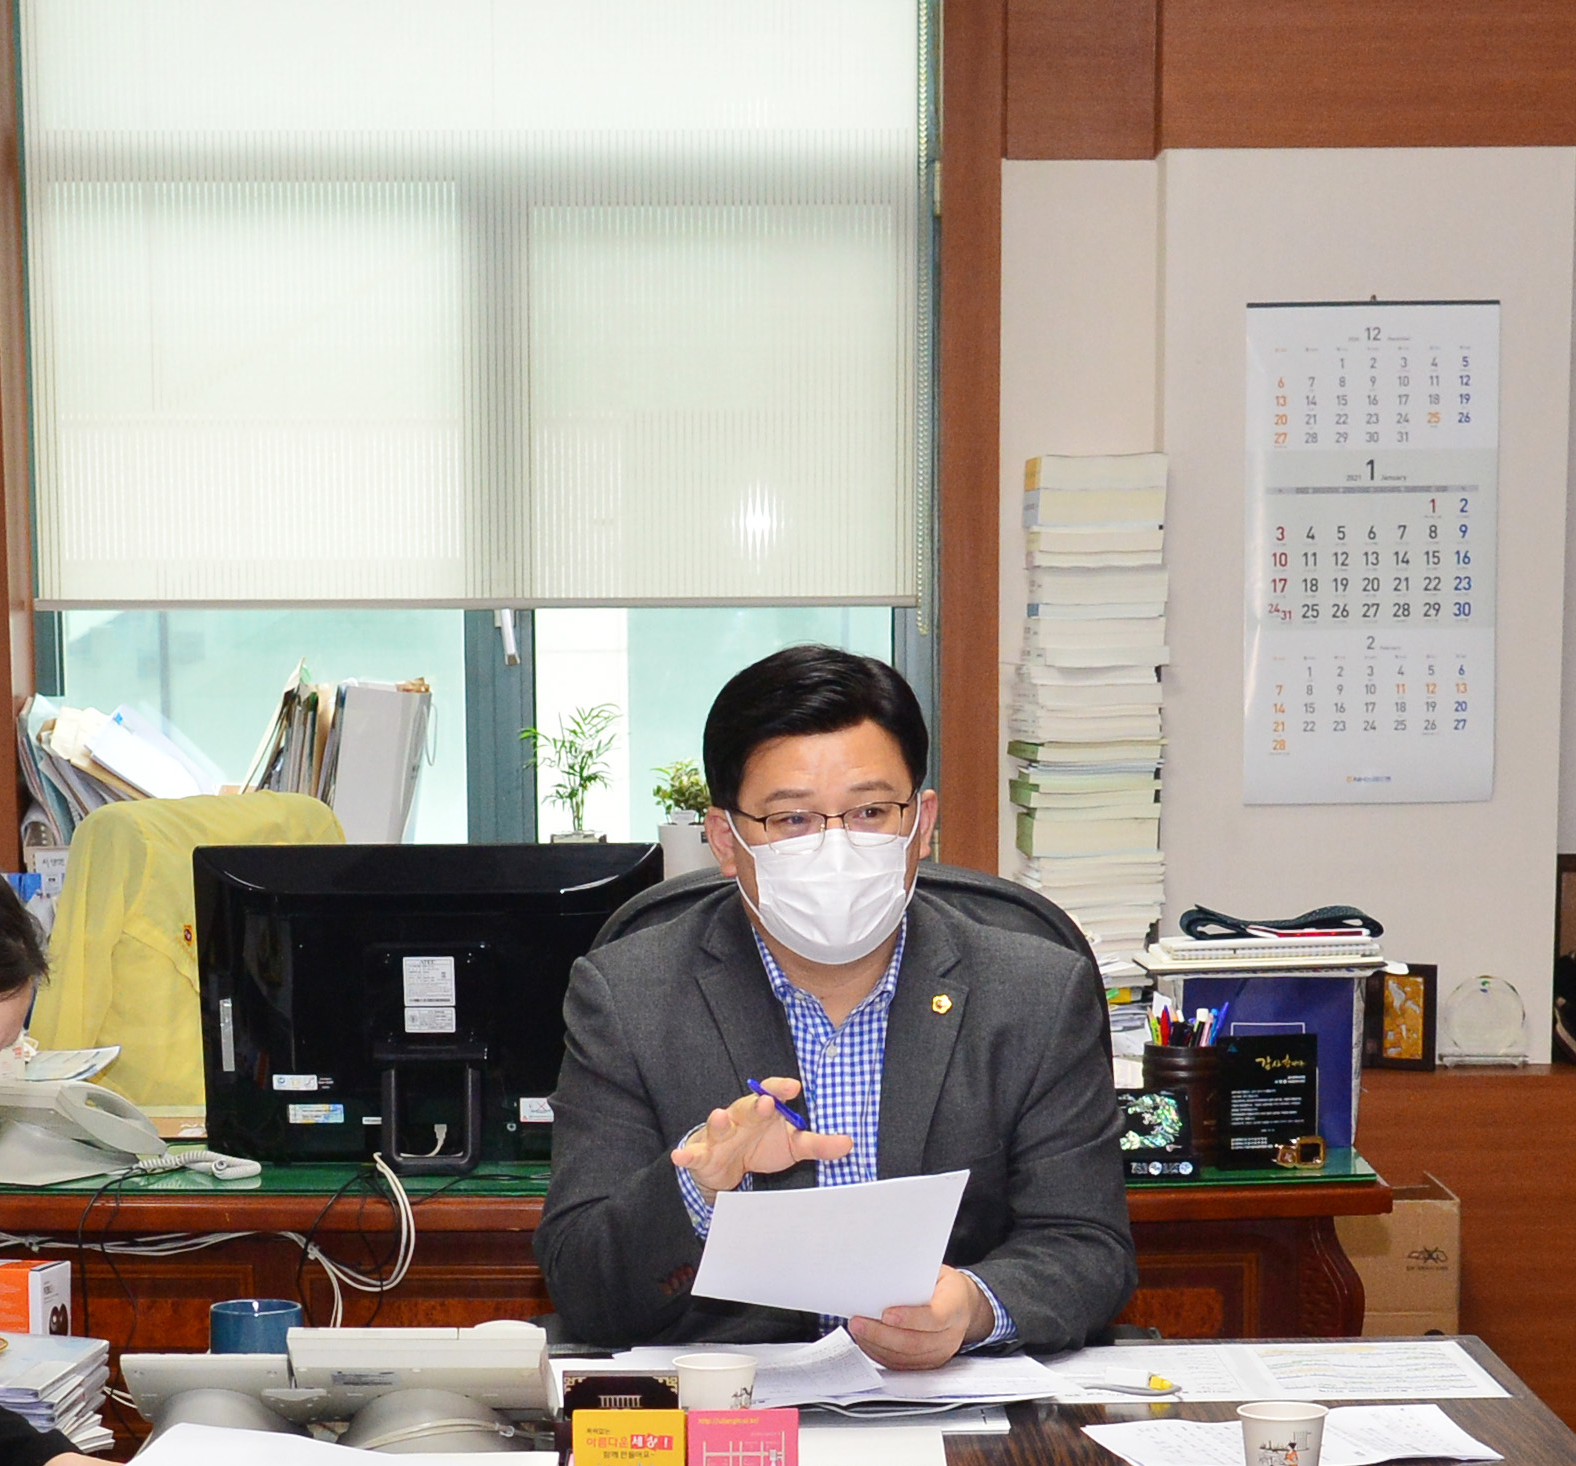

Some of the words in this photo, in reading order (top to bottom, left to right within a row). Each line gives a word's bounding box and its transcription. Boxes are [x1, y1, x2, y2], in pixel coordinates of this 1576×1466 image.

[1365, 327, 1381, 341] 12
[1339, 358, 1345, 369] 1
[1370, 357, 1377, 368] 2
[1401, 357, 1407, 368] 3
[1431, 357, 1438, 367] 4
[1462, 356, 1469, 367] 5
[1278, 377, 1284, 388] 6
[1308, 376, 1315, 387] 7
[1339, 376, 1346, 387] 8
[1370, 376, 1376, 387] 9
[1398, 376, 1409, 387] 10
[1430, 375, 1439, 386] 11
[1459, 375, 1470, 386] 12
[1276, 395, 1287, 407] 13
[1306, 395, 1317, 406] 14
[1337, 395, 1348, 406] 15
[1367, 395, 1378, 406] 16
[1398, 394, 1409, 405] 17
[1429, 394, 1440, 405] 18
[1459, 393, 1470, 404] 19
[1275, 414, 1288, 425] 20
[1306, 414, 1317, 425] 21
[1335, 413, 1348, 425] 22
[1366, 413, 1379, 424] 23
[1396, 413, 1409, 424] 24
[1427, 412, 1441, 424] 25
[1458, 412, 1470, 423] 26
[1275, 432, 1287, 444] 27
[1305, 432, 1318, 444] 28
[1335, 432, 1348, 443] 29
[1366, 431, 1379, 443] 30
[1397, 431, 1408, 442] 31
[1366, 459, 1375, 481] 1
[1429, 499, 1435, 514] 1
[1460, 498, 1468, 513] 2
[1276, 526, 1285, 541] 3
[1306, 526, 1315, 540] 4
[1337, 526, 1345, 540] 5
[1368, 526, 1376, 540] 6
[1398, 525, 1407, 539] 7
[1429, 525, 1437, 539] 8
[1459, 524, 1468, 538] 9
[1273, 552, 1287, 567] 10
[1303, 552, 1316, 566] 11
[1333, 552, 1349, 566] 12
[1363, 551, 1379, 566] 13
[1394, 551, 1410, 565] 14
[1424, 550, 1440, 565] 15
[1455, 550, 1470, 565] 16
[1272, 578, 1287, 593] 17
[1302, 578, 1318, 592] 18
[1333, 578, 1348, 592] 19
[1362, 577, 1380, 592] 20
[1393, 577, 1409, 591] 21
[1424, 576, 1441, 591] 22
[1454, 576, 1471, 591] 23
[1268, 603, 1280, 614] 24
[1281, 610, 1292, 621] 31
[1302, 604, 1319, 618] 25
[1332, 604, 1349, 618] 26
[1362, 603, 1380, 617] 27
[1393, 603, 1410, 617] 28
[1424, 602, 1441, 617] 29
[1453, 602, 1471, 617] 30
[1366, 636, 1375, 650] 2
[1307, 666, 1312, 677] 1
[1337, 666, 1343, 677] 2
[1367, 666, 1374, 677] 3
[1397, 666, 1404, 676] 4
[1428, 665, 1435, 676] 5
[1459, 665, 1465, 675] 6
[1276, 685, 1283, 695] 7
[1306, 685, 1313, 695] 8
[1337, 684, 1343, 695] 9
[1365, 684, 1376, 695] 10
[1396, 683, 1405, 694] 11
[1426, 683, 1437, 694] 12
[1456, 682, 1467, 693] 13
[1274, 703, 1285, 714] 14
[1304, 703, 1315, 714] 15
[1334, 703, 1346, 713] 16
[1365, 702, 1376, 713] 17
[1395, 702, 1406, 712] 18
[1426, 701, 1436, 712] 19
[1455, 701, 1467, 712] 20
[1273, 721, 1285, 732] 21
[1303, 721, 1315, 732] 22
[1333, 721, 1346, 732] 23
[1364, 720, 1376, 731] 24
[1394, 720, 1406, 731] 25
[1424, 719, 1436, 730] 26
[1454, 719, 1466, 730] 27
[1273, 739, 1286, 750] 28
[586, 1437, 629, 1449] 아름다운
